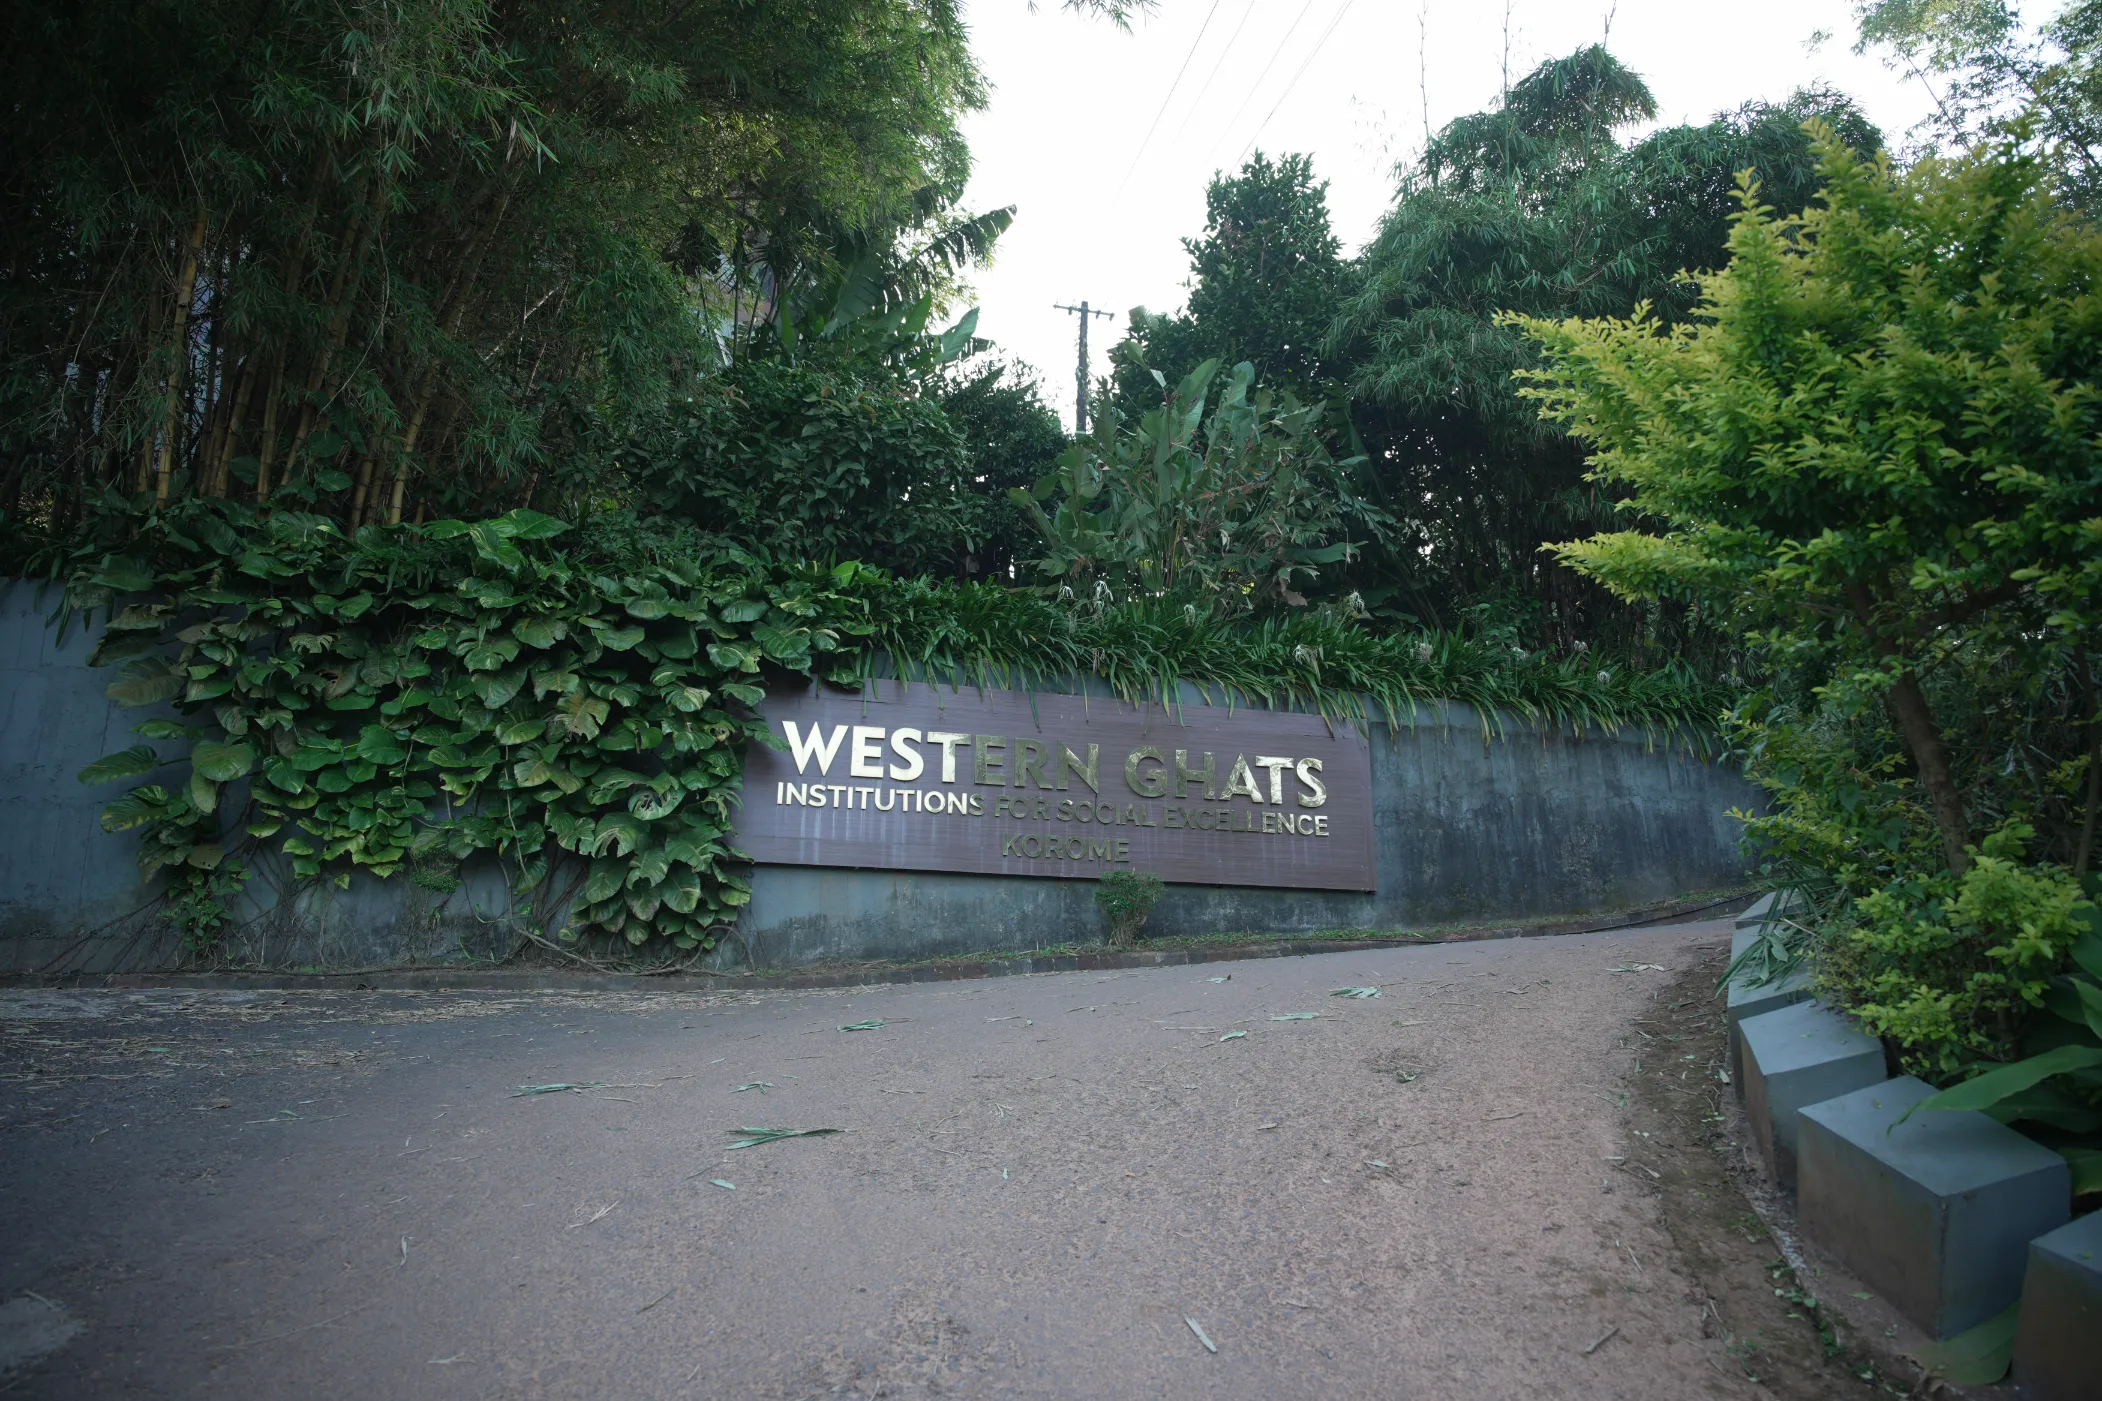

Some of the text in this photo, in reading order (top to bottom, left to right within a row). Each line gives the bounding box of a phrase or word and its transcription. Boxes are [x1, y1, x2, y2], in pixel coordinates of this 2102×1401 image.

[782, 721, 1327, 808] WESTERN GHATS
[776, 781, 1330, 837] INSTITUTIONS FOR SOCIAL EXCELLENCE
[1003, 833, 1130, 862] KOROME
